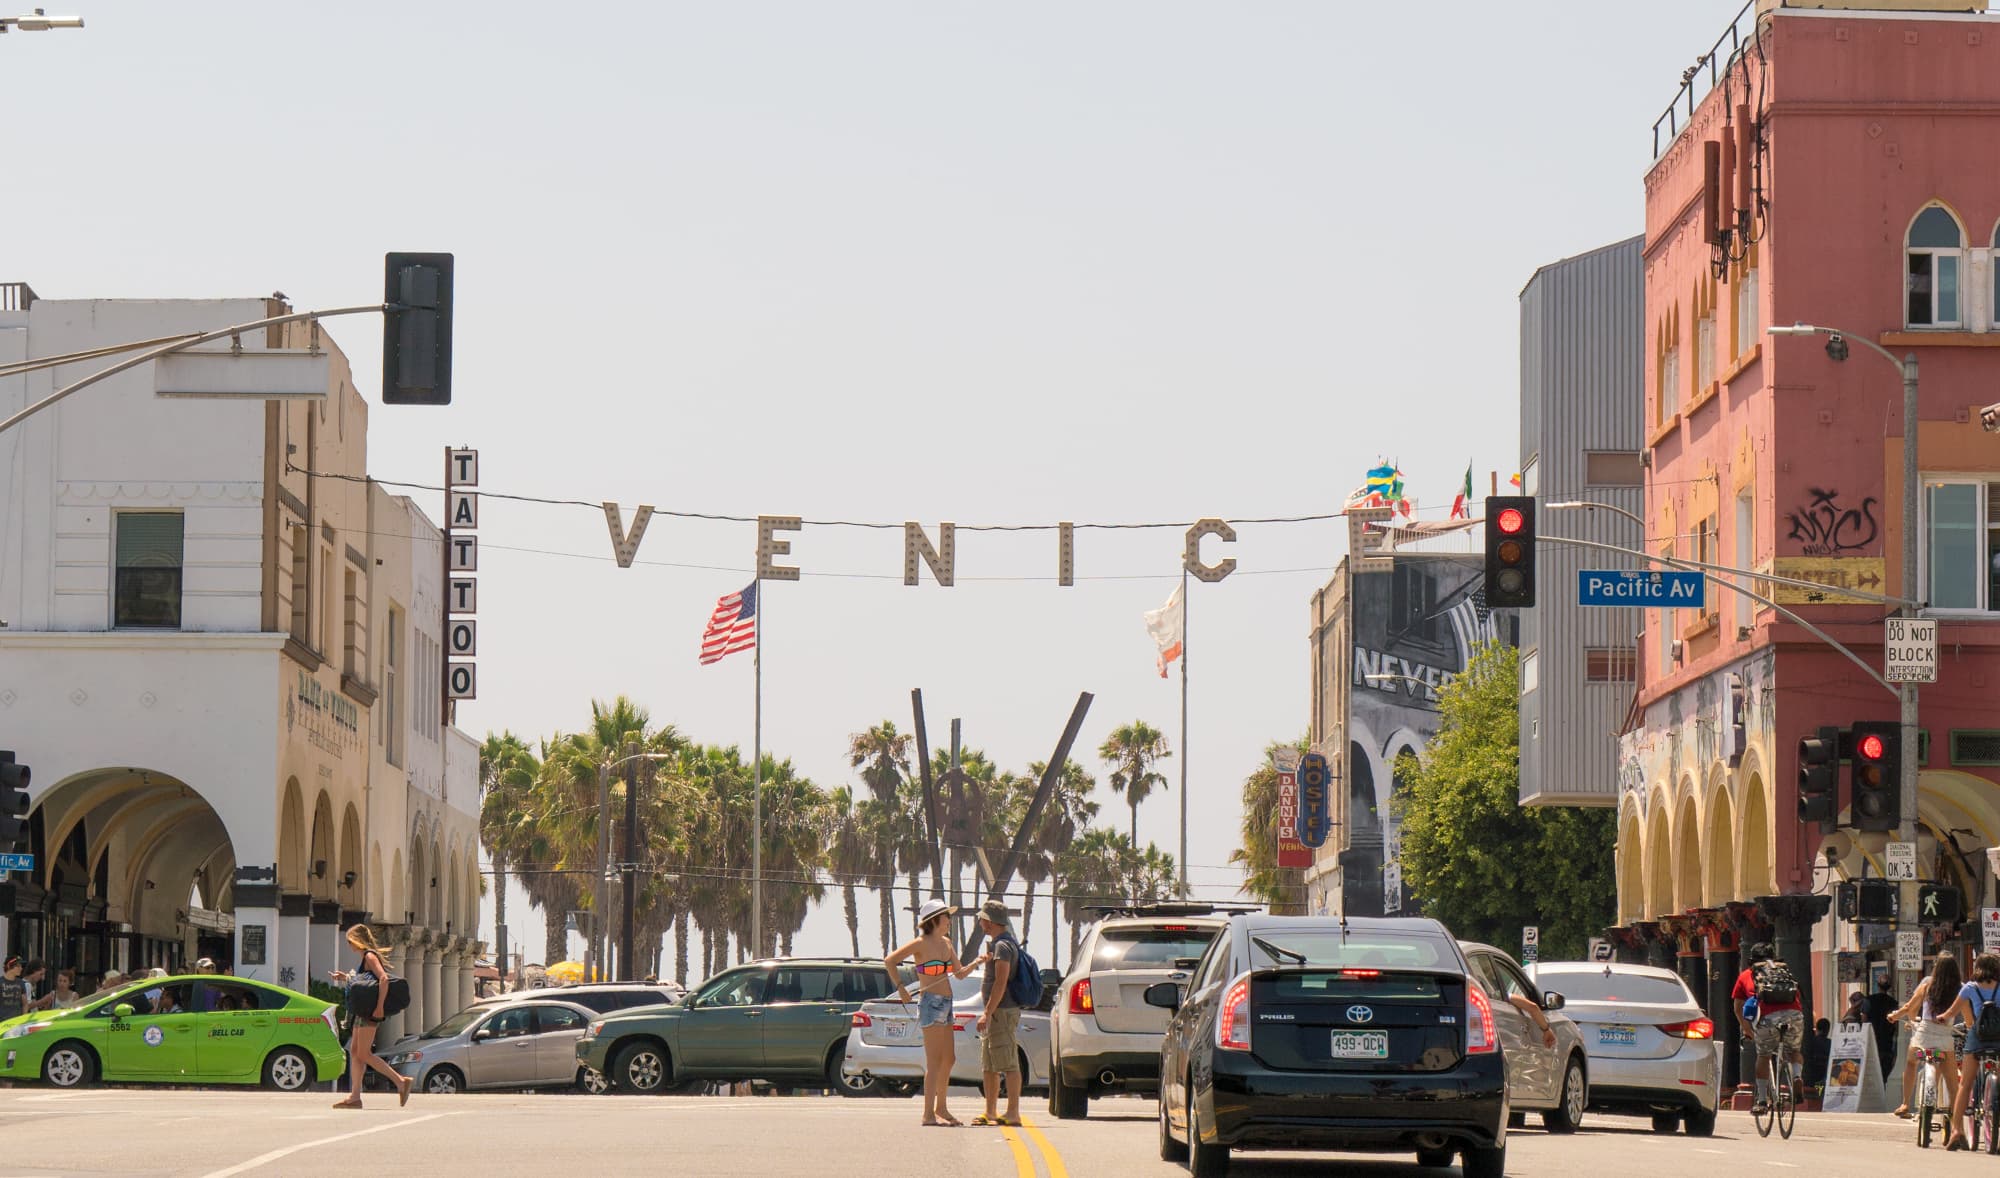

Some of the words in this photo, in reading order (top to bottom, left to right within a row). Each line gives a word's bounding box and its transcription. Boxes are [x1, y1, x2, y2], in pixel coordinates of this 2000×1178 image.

[602, 502, 1394, 586] VENICE
[452, 455, 473, 694] TATTOO
[1588, 578, 1662, 597] Pacific
[1669, 579, 1695, 597] Av
[1888, 627, 1904, 641] DO
[1911, 627, 1934, 641] NOT
[1888, 647, 1933, 661] BLOCK
[1305, 759, 1323, 842] HOSTEL
[1888, 862, 1899, 877] OK
[212, 1028, 229, 1037] BELL
[230, 1028, 245, 1036] CAB
